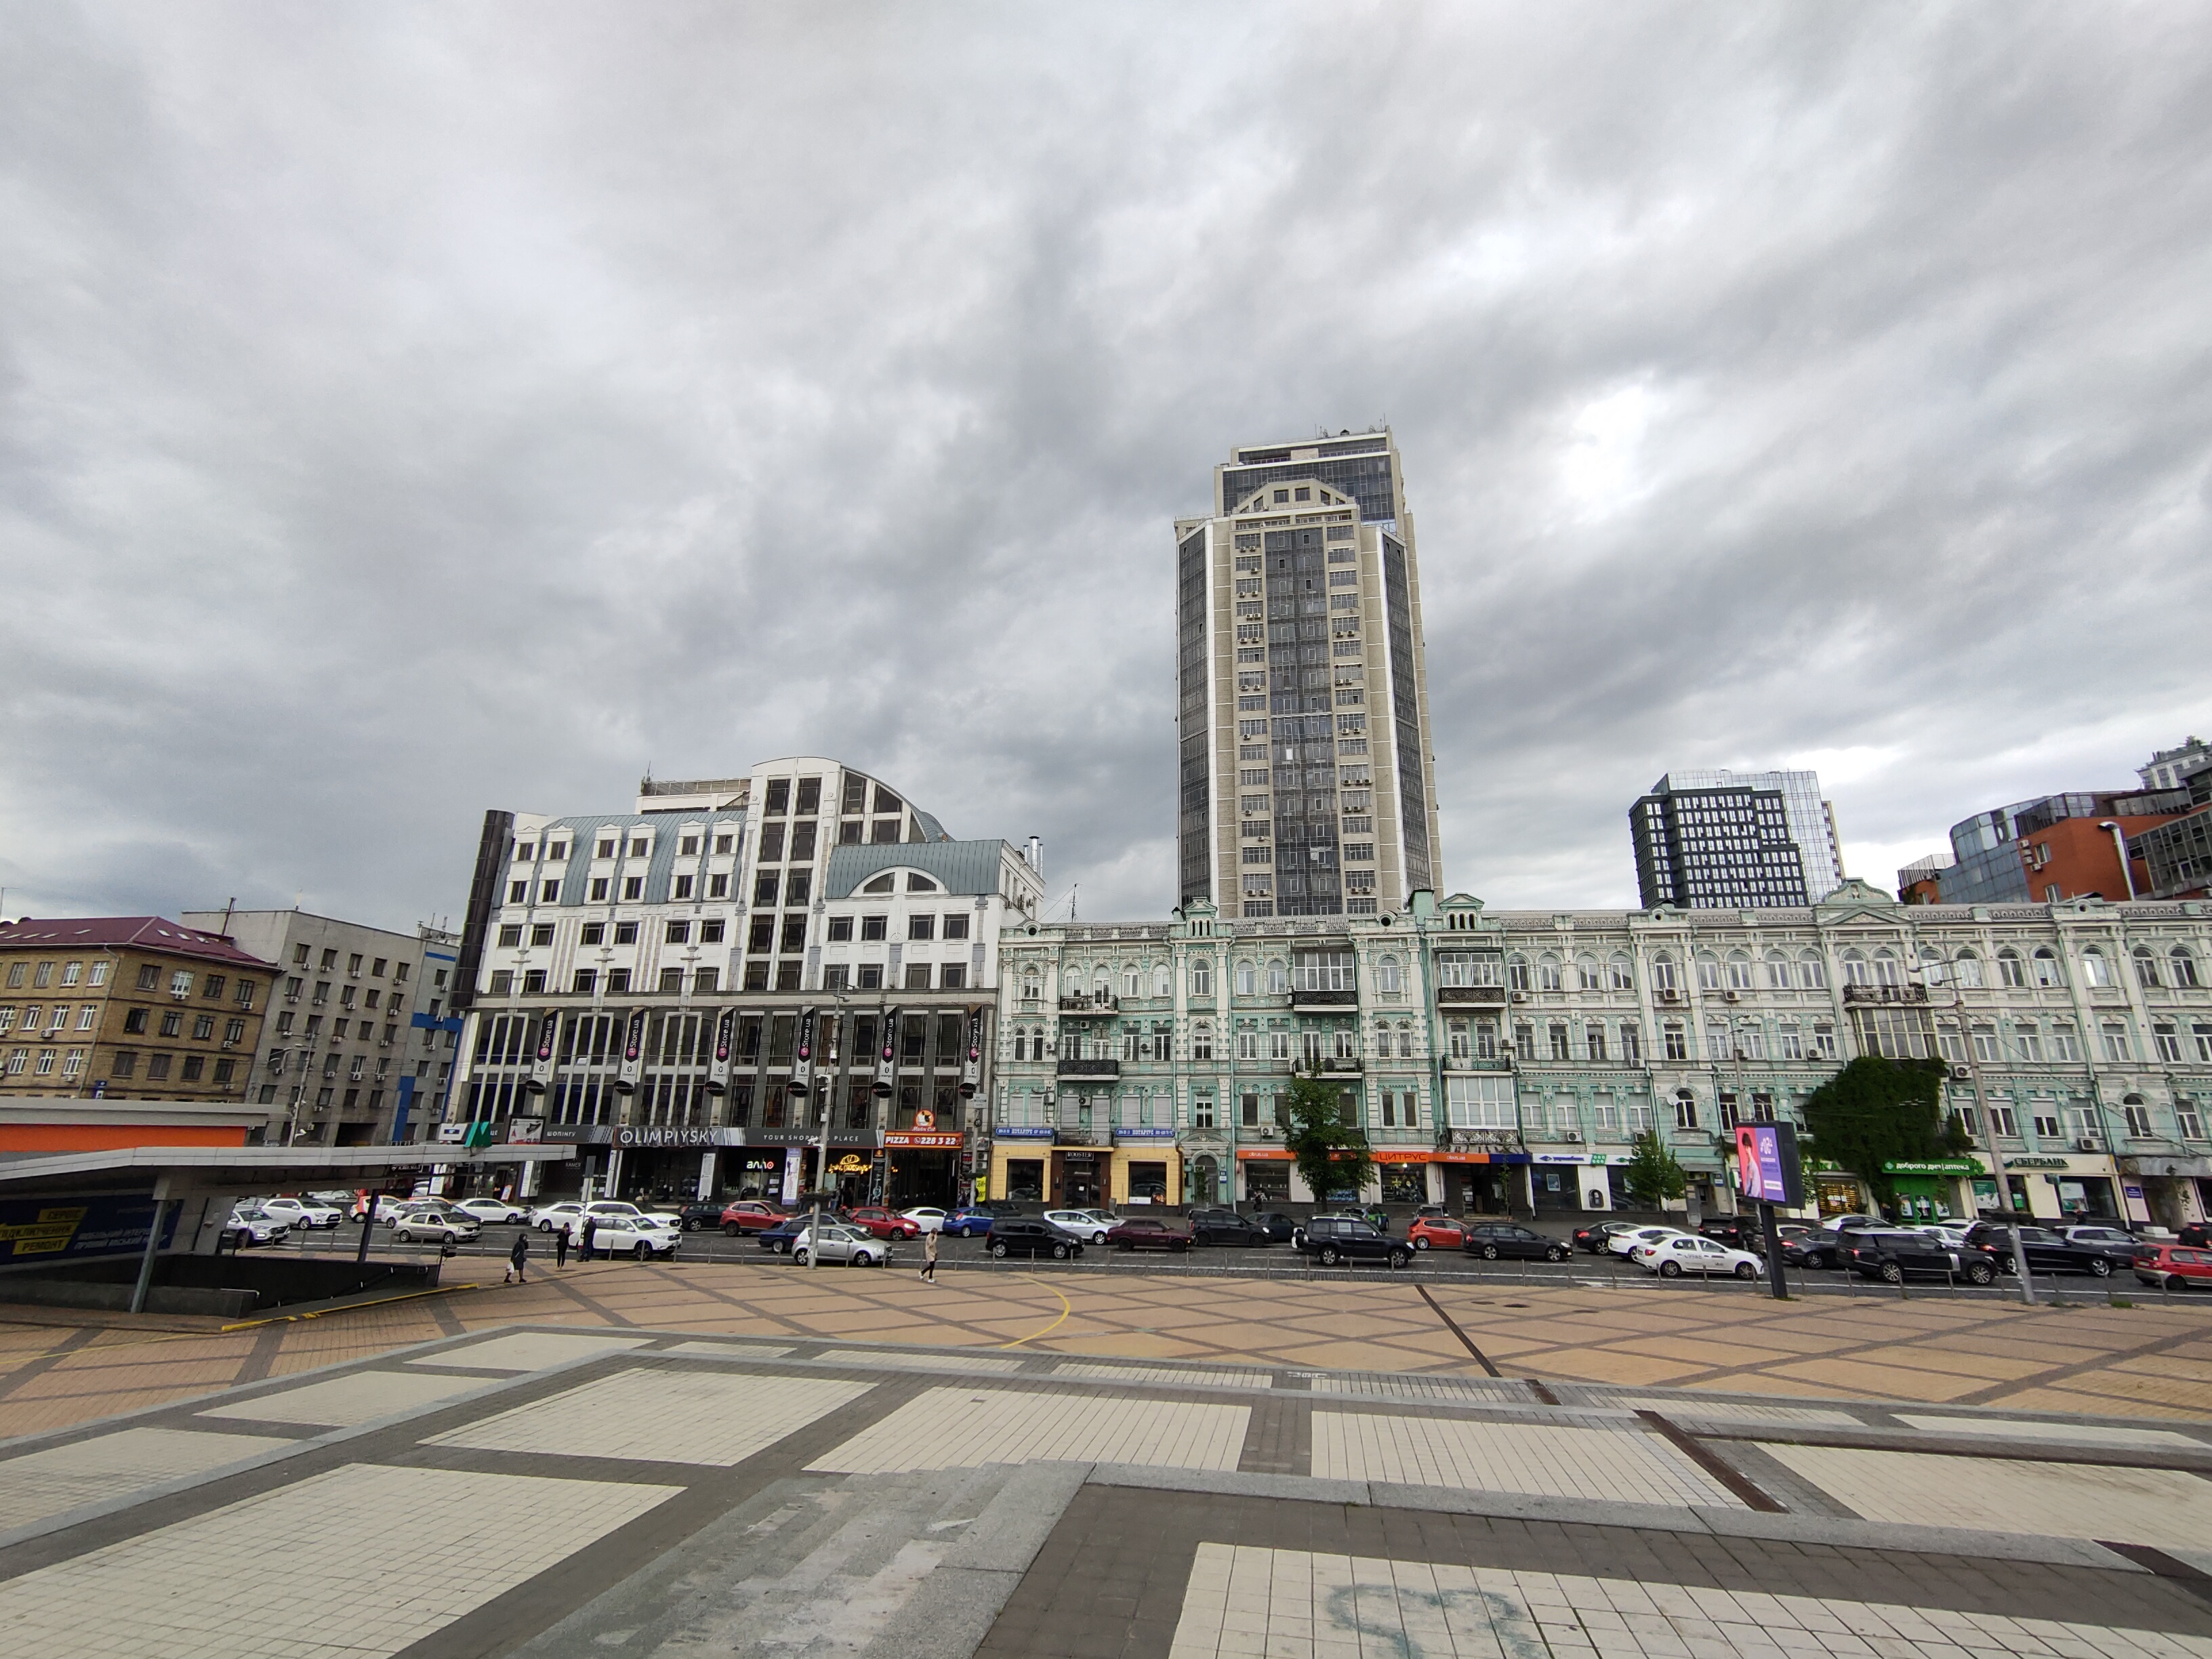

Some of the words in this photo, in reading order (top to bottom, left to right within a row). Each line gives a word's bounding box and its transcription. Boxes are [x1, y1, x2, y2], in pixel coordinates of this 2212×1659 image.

[620, 1130, 718, 1143] OLIMPIYSKY
[920, 1136, 936, 1145] 228
[1379, 1153, 1427, 1161] ЦИТРУС
[1896, 1162, 1926, 1170] доброго
[2014, 1158, 2069, 1166] СБЕРБАНК
